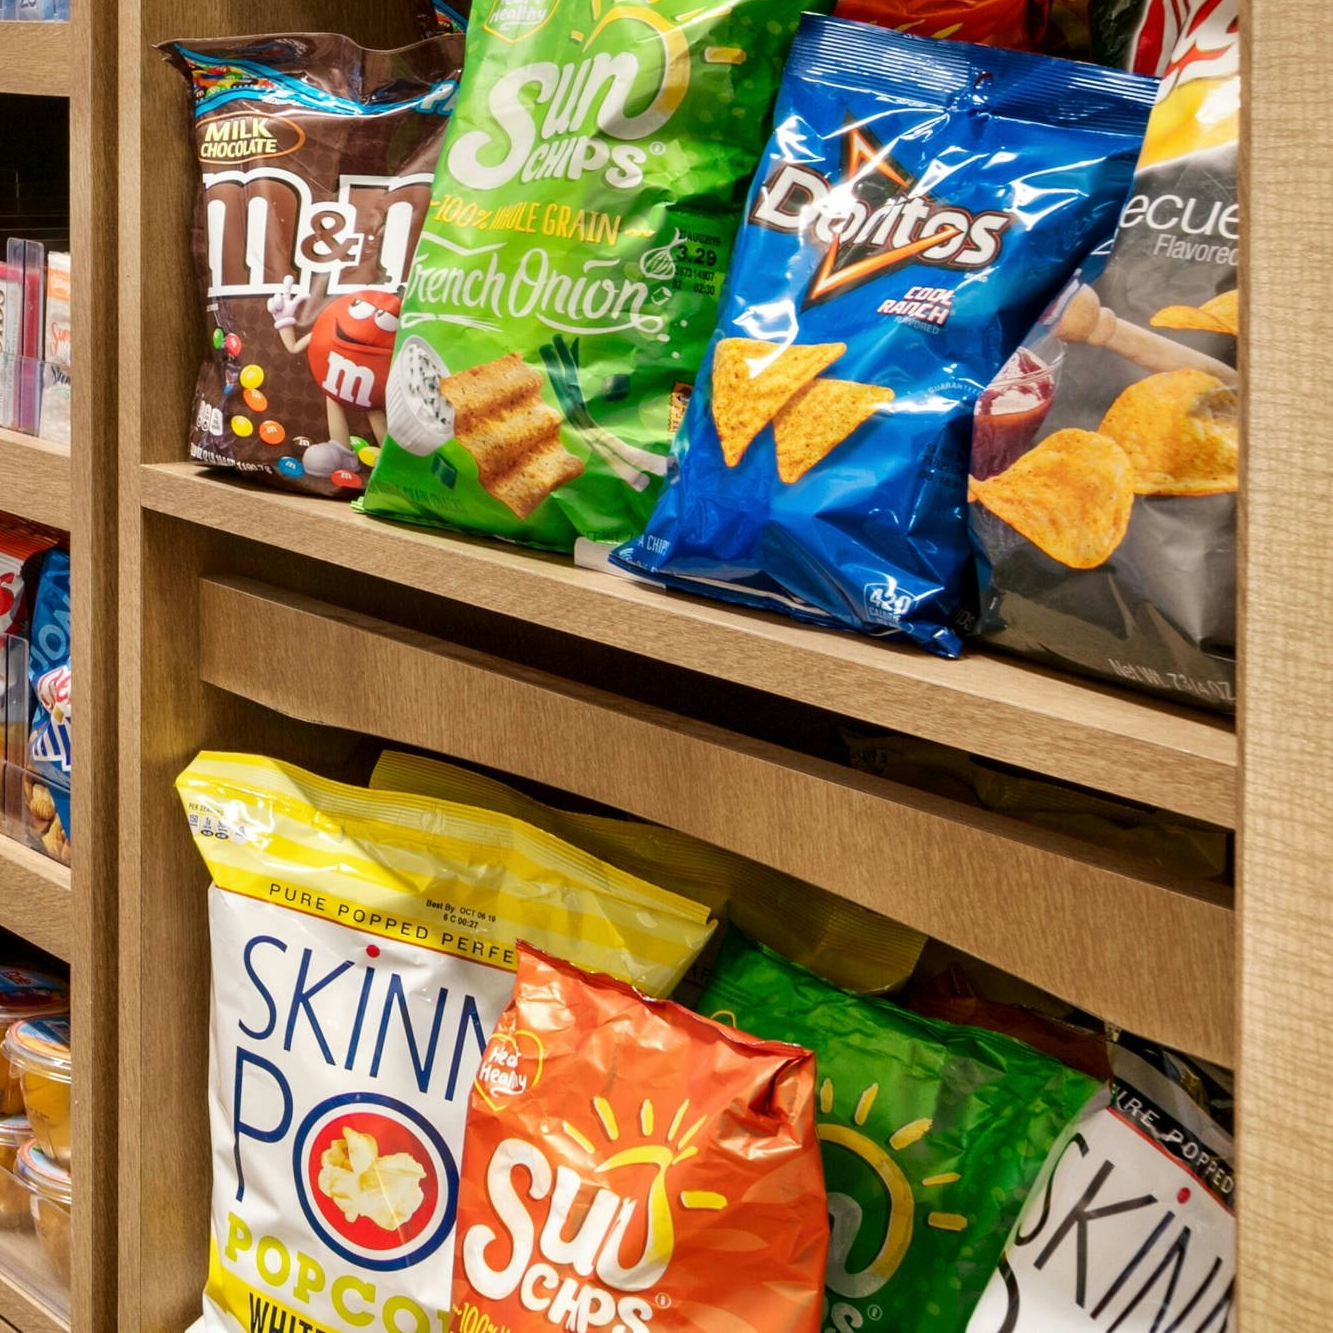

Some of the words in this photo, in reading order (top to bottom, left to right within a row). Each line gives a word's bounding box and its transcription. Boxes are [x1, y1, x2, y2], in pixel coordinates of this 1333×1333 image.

[447, 11, 688, 191] Sun
[200, 137, 278, 159] CHOCOLATE
[203, 116, 275, 142] MILK
[526, 135, 645, 191] CHIPS
[493, 203, 540, 234] WHOLE
[541, 203, 623, 246] GRAIN
[753, 166, 1009, 268] Doritos
[676, 245, 718, 266] 3.29
[509, 247, 665, 334] Onion
[877, 298, 952, 326] RANCH
[904, 285, 955, 306] COOL
[269, 883, 326, 911] PURE
[338, 904, 429, 939] POPPED
[441, 932, 515, 965] PERFE
[426, 899, 444, 911] Best
[445, 902, 455, 914] By
[460, 906, 476, 918] OCT
[464, 1138, 674, 1301] Sun
